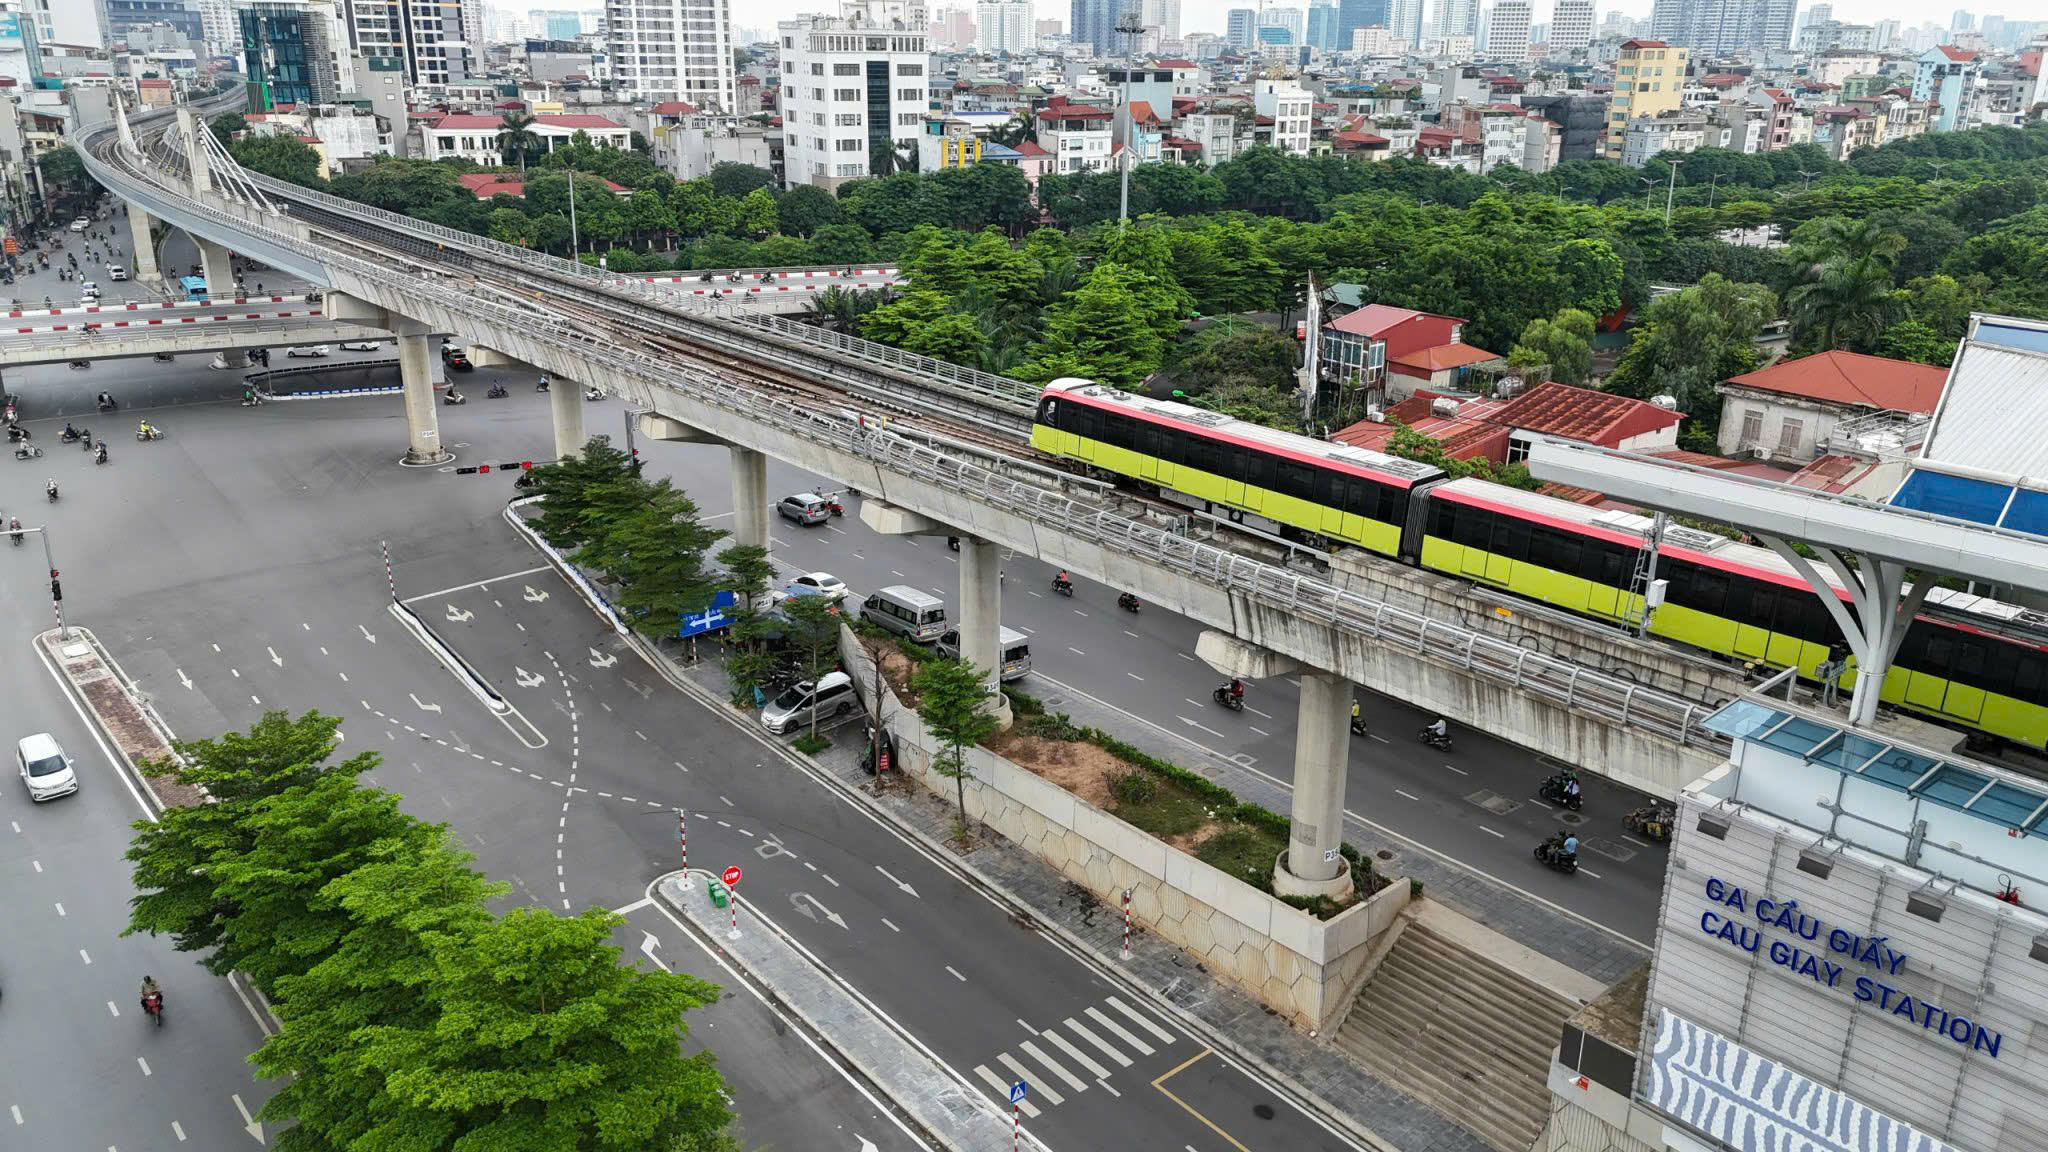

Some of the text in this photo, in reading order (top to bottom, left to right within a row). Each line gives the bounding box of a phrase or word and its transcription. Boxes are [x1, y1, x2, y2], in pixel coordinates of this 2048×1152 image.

[725, 870, 739, 880] STOP
[1705, 877, 1906, 976] GA CẦU GIẤY
[1700, 911, 2002, 1059] CAU GIAY STATION
